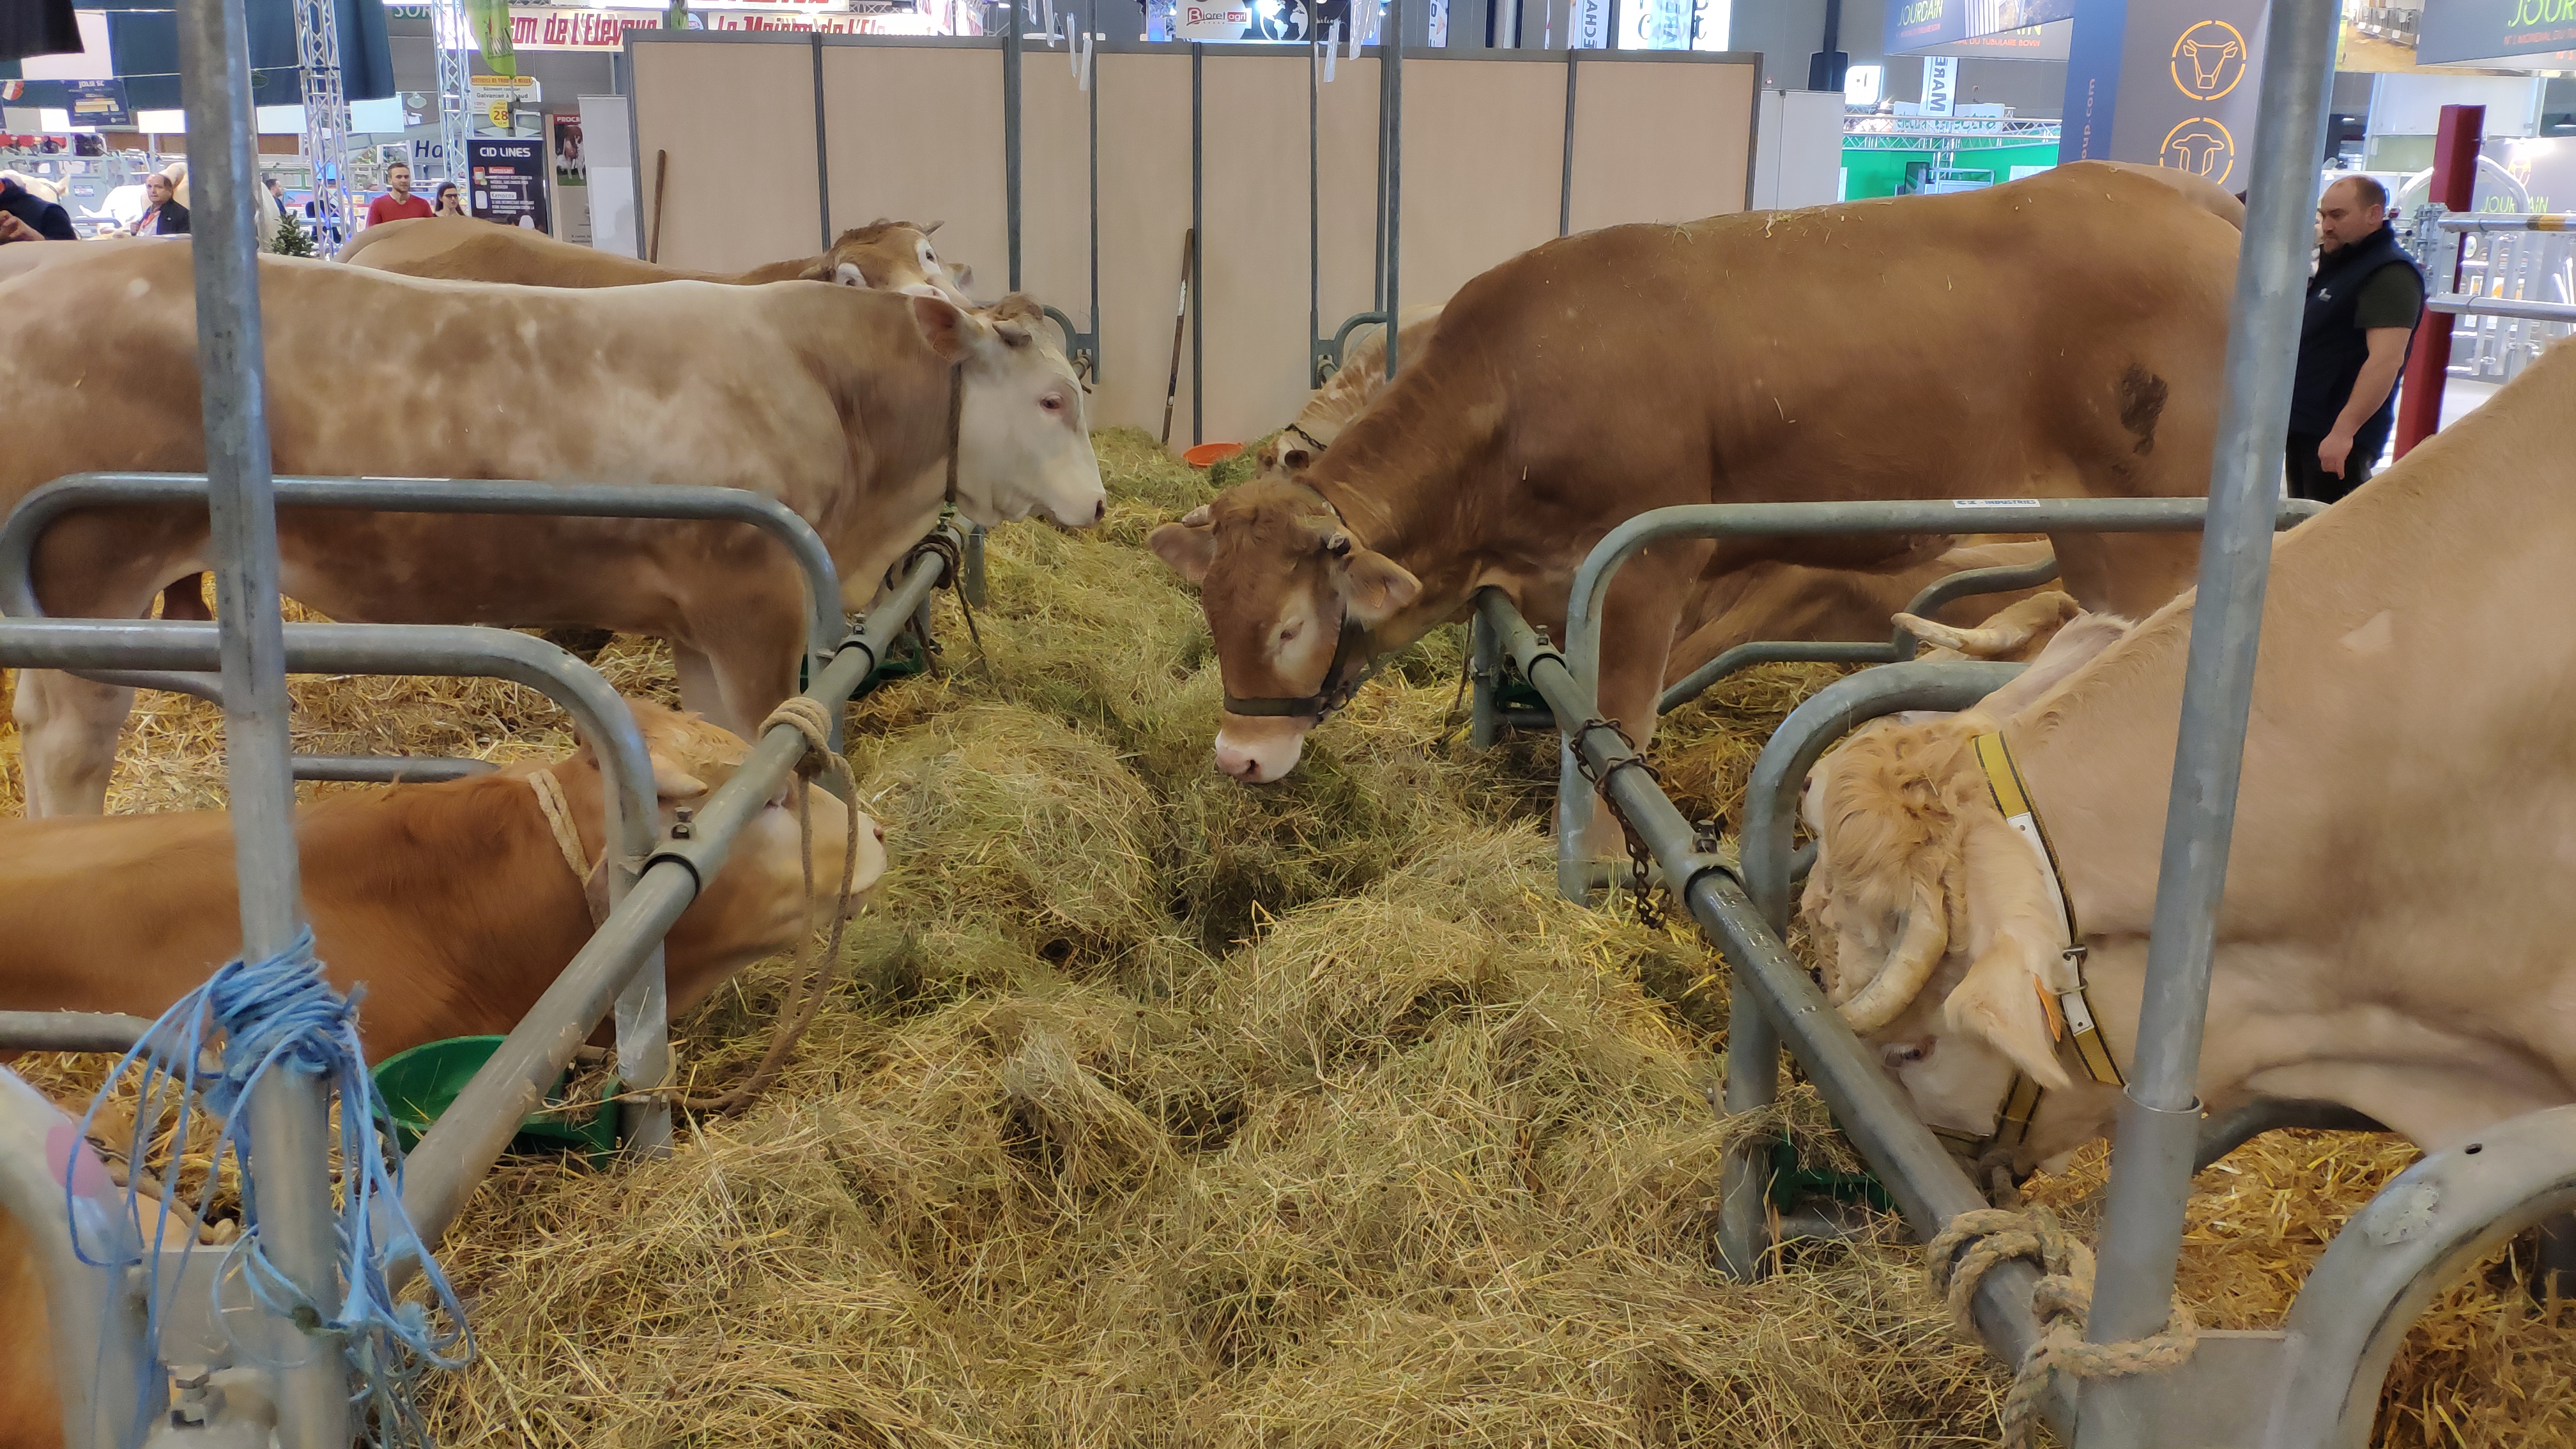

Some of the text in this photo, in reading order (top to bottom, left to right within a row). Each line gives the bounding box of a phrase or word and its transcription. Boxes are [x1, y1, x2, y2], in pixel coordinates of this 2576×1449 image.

[493, 110, 509, 121] 28
[480, 147, 531, 157] CID LINES
[2480, 195, 2549, 213] JOURAIN
